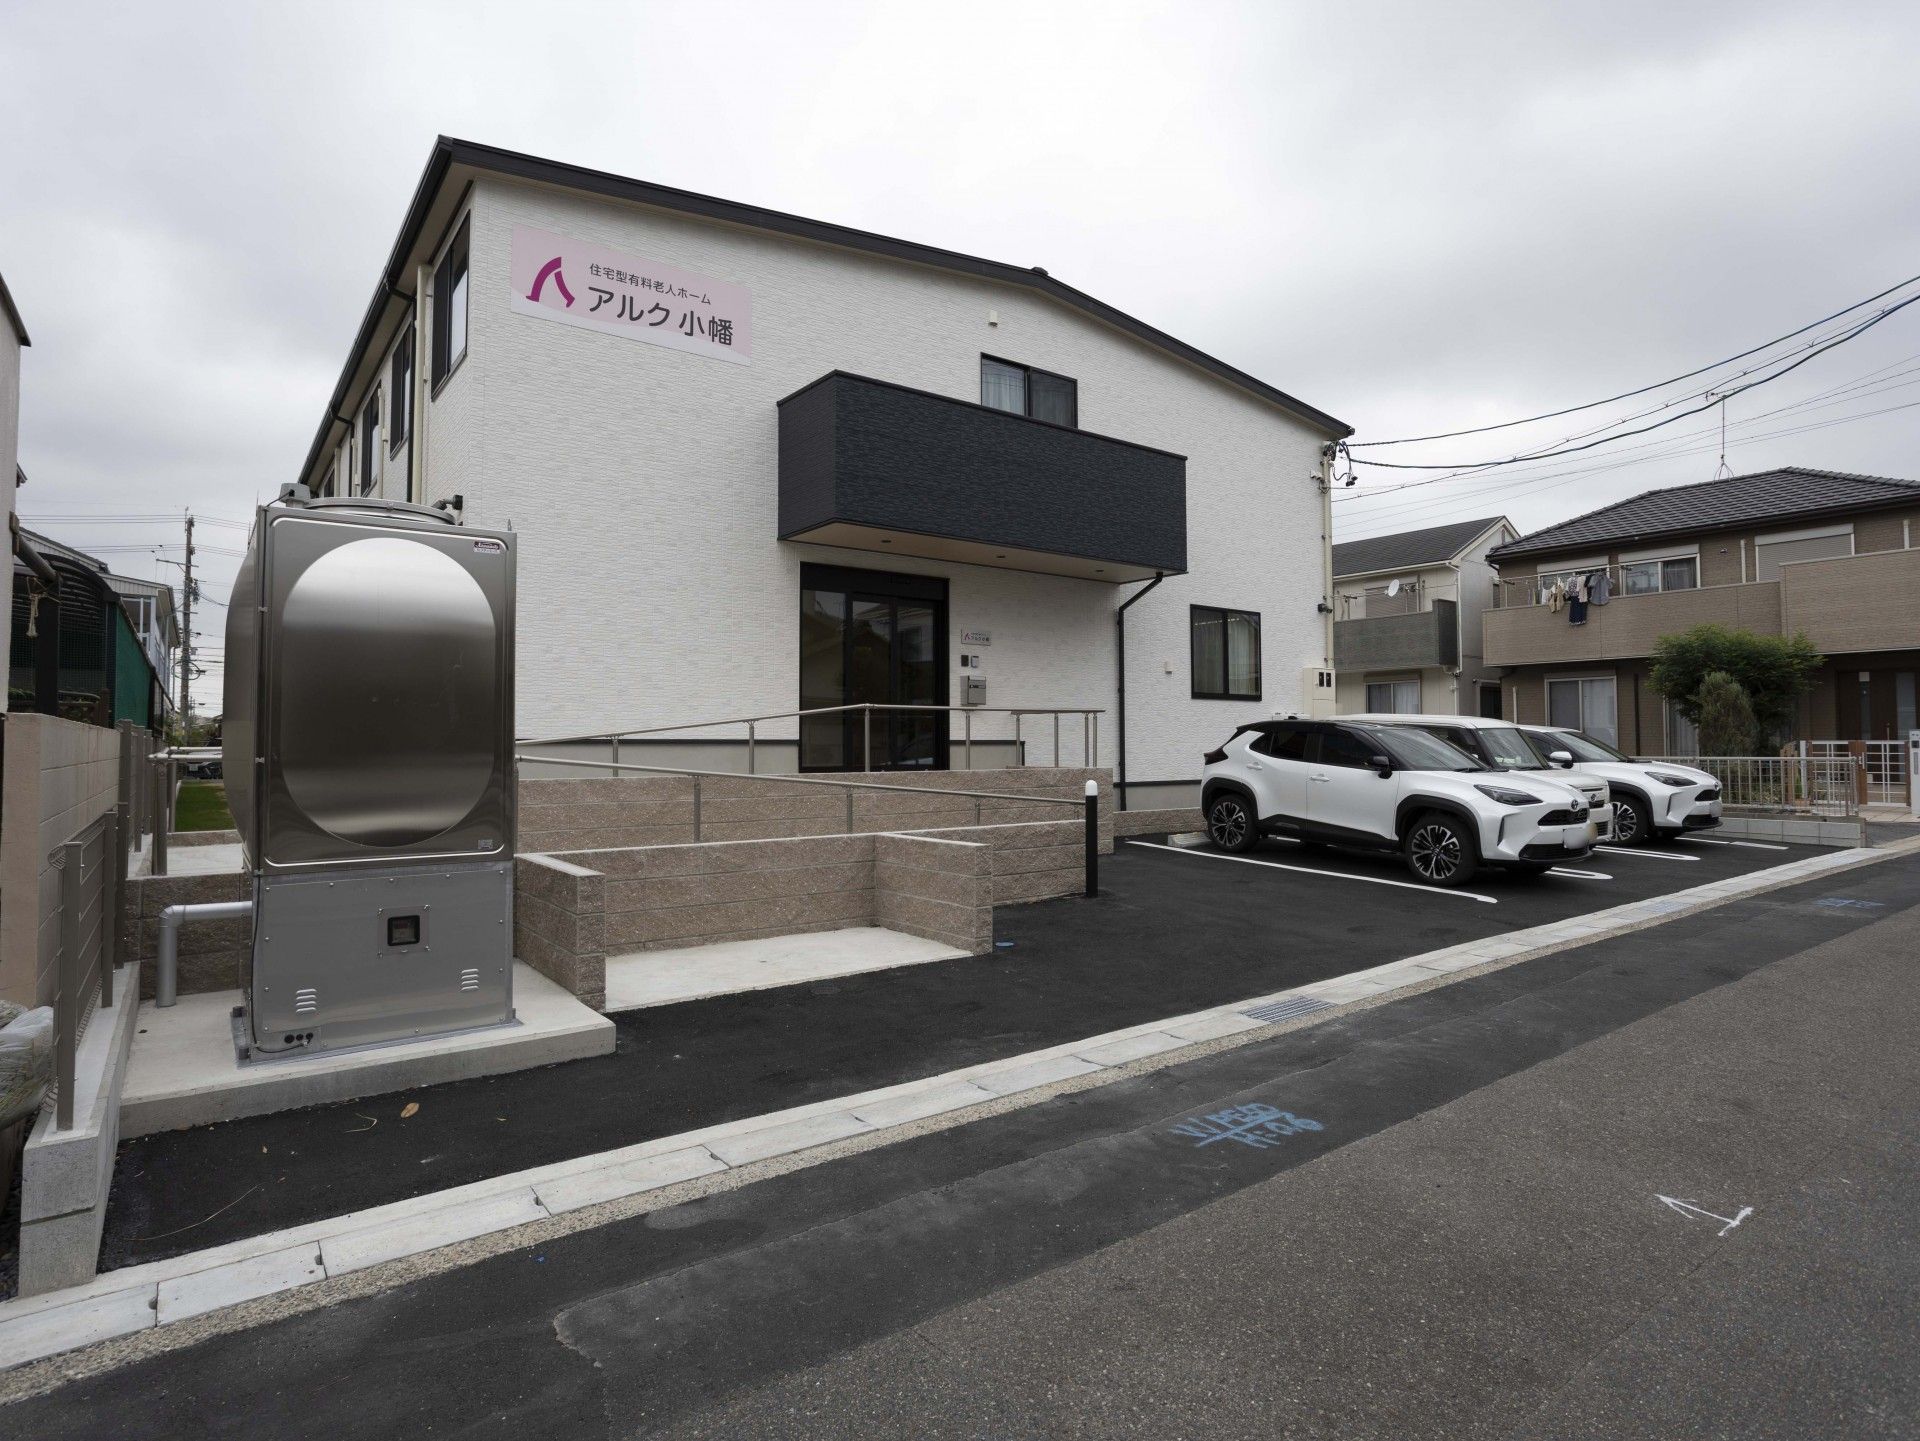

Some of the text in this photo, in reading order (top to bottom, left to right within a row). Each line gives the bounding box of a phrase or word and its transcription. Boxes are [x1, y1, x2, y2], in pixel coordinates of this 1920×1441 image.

[589, 263, 711, 305] 住宅型有料老人ホーム
